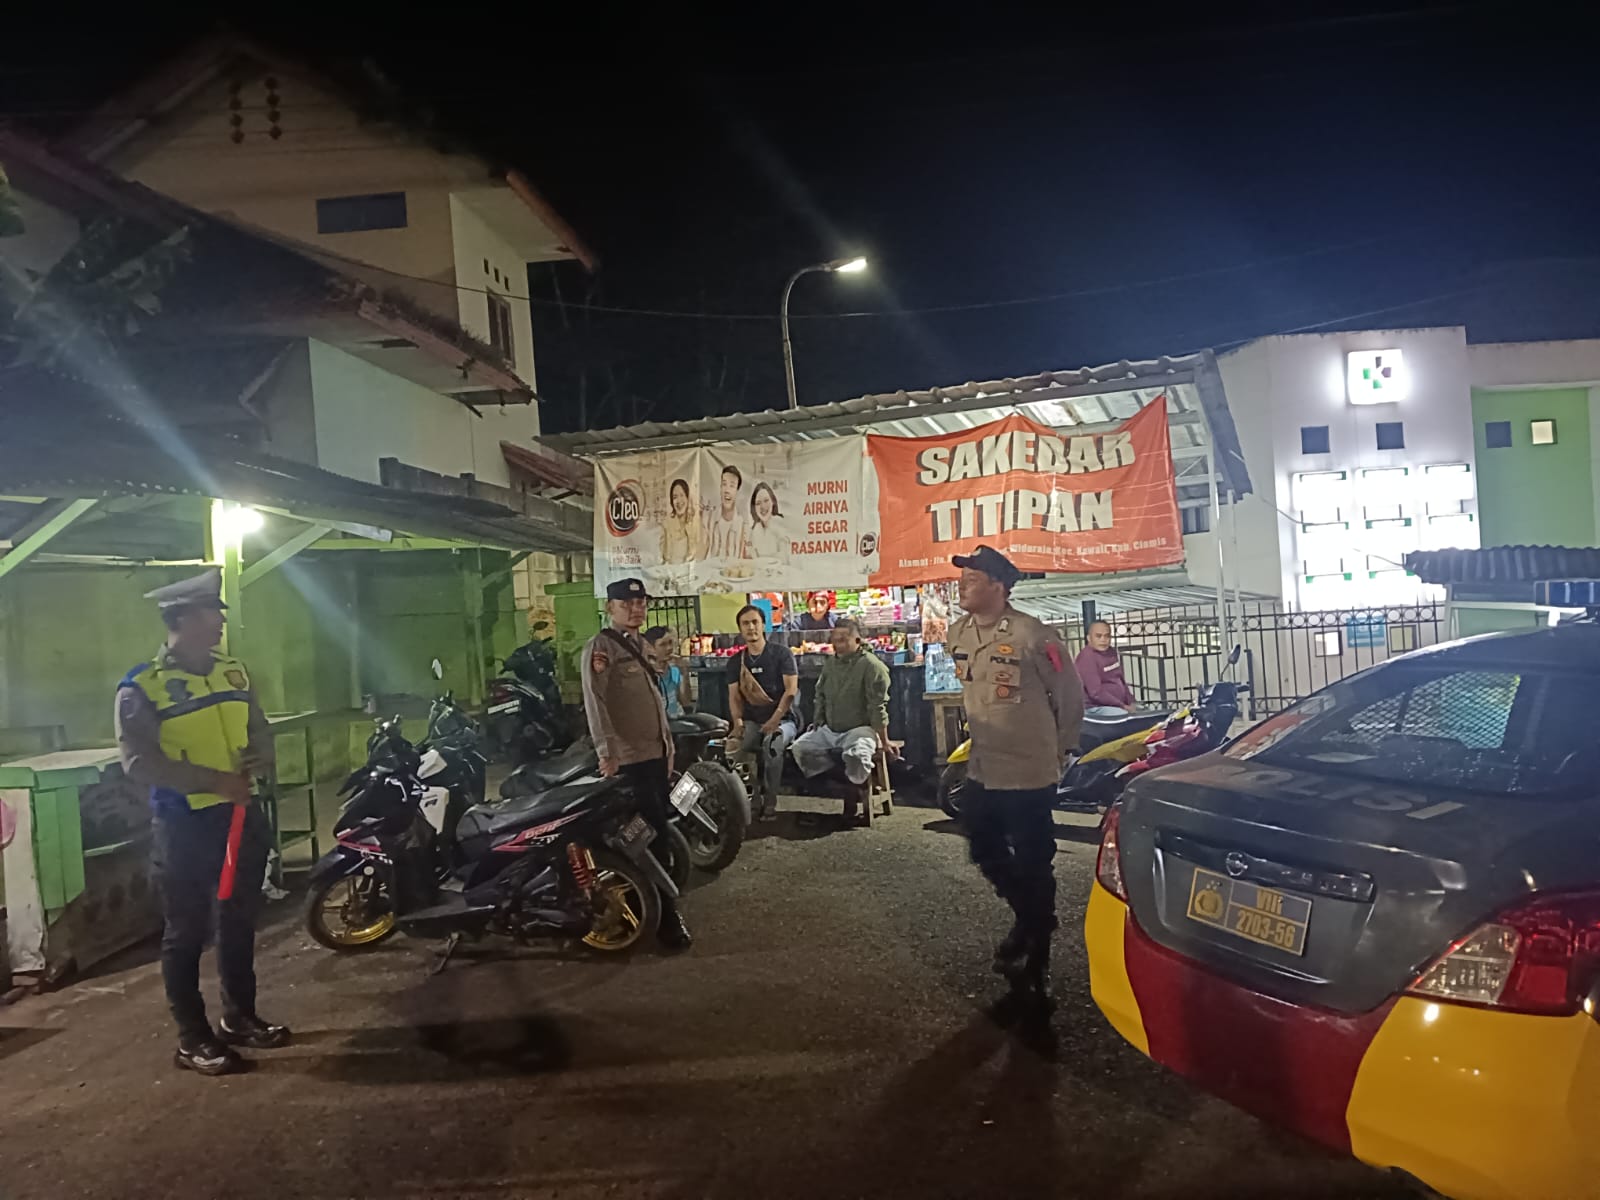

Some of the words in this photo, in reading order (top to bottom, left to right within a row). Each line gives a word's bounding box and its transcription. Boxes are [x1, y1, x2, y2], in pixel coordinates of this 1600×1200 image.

[807, 480, 848, 495] MURNI
[612, 497, 639, 520] Cleo
[803, 499, 848, 516] AIRNYA
[928, 489, 1113, 542] TITIPAN
[807, 520, 848, 534] SEGAR
[791, 539, 848, 555] RASANYA
[1236, 908, 1296, 948] 2703-56
